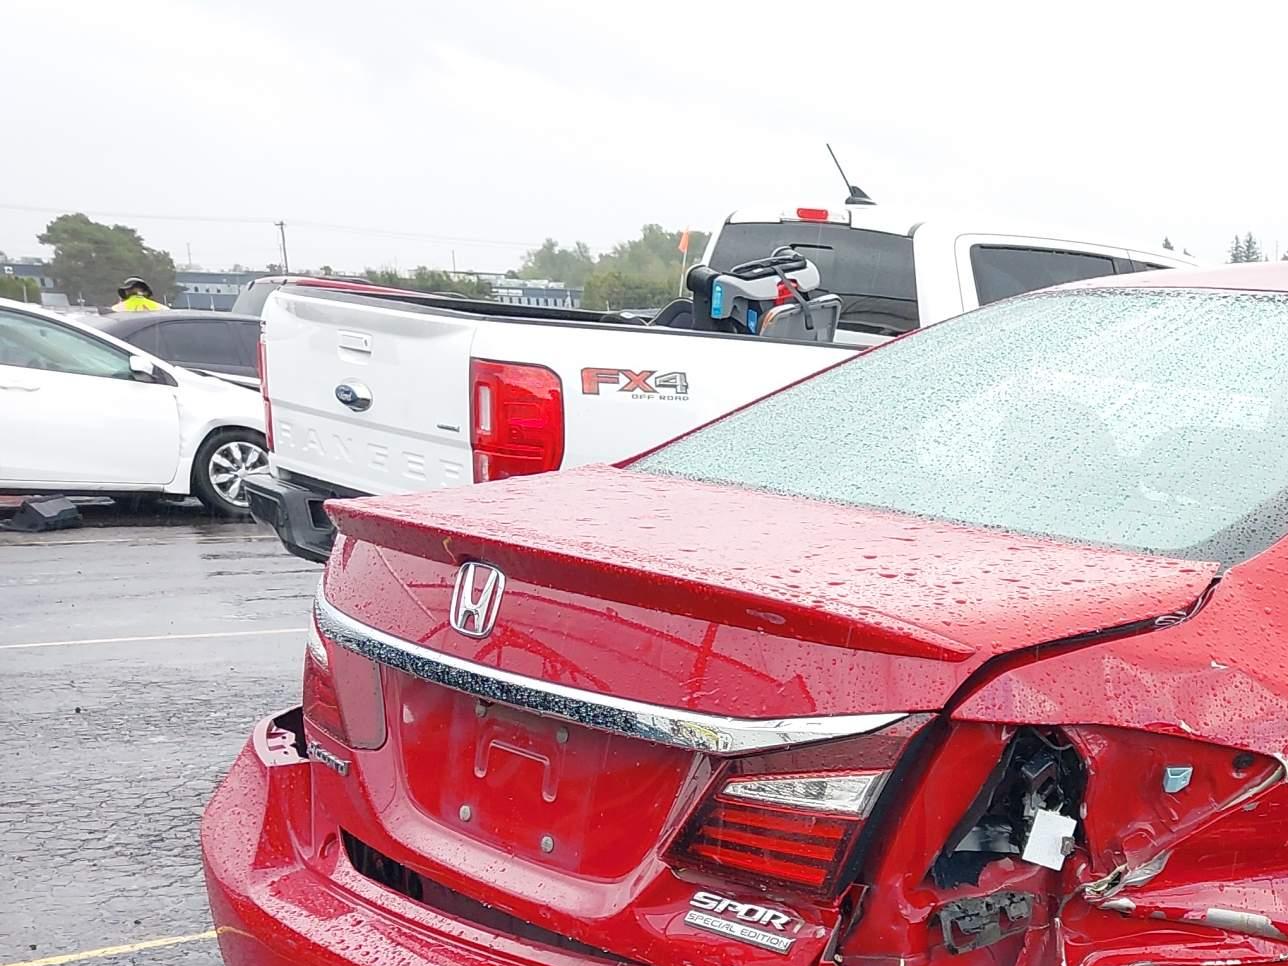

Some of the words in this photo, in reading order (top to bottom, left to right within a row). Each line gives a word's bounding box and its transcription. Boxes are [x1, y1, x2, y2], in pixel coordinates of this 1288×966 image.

[581, 367, 689, 395] FX4
[687, 912, 736, 934] SPECIAL
[740, 928, 790, 949] EDITION
